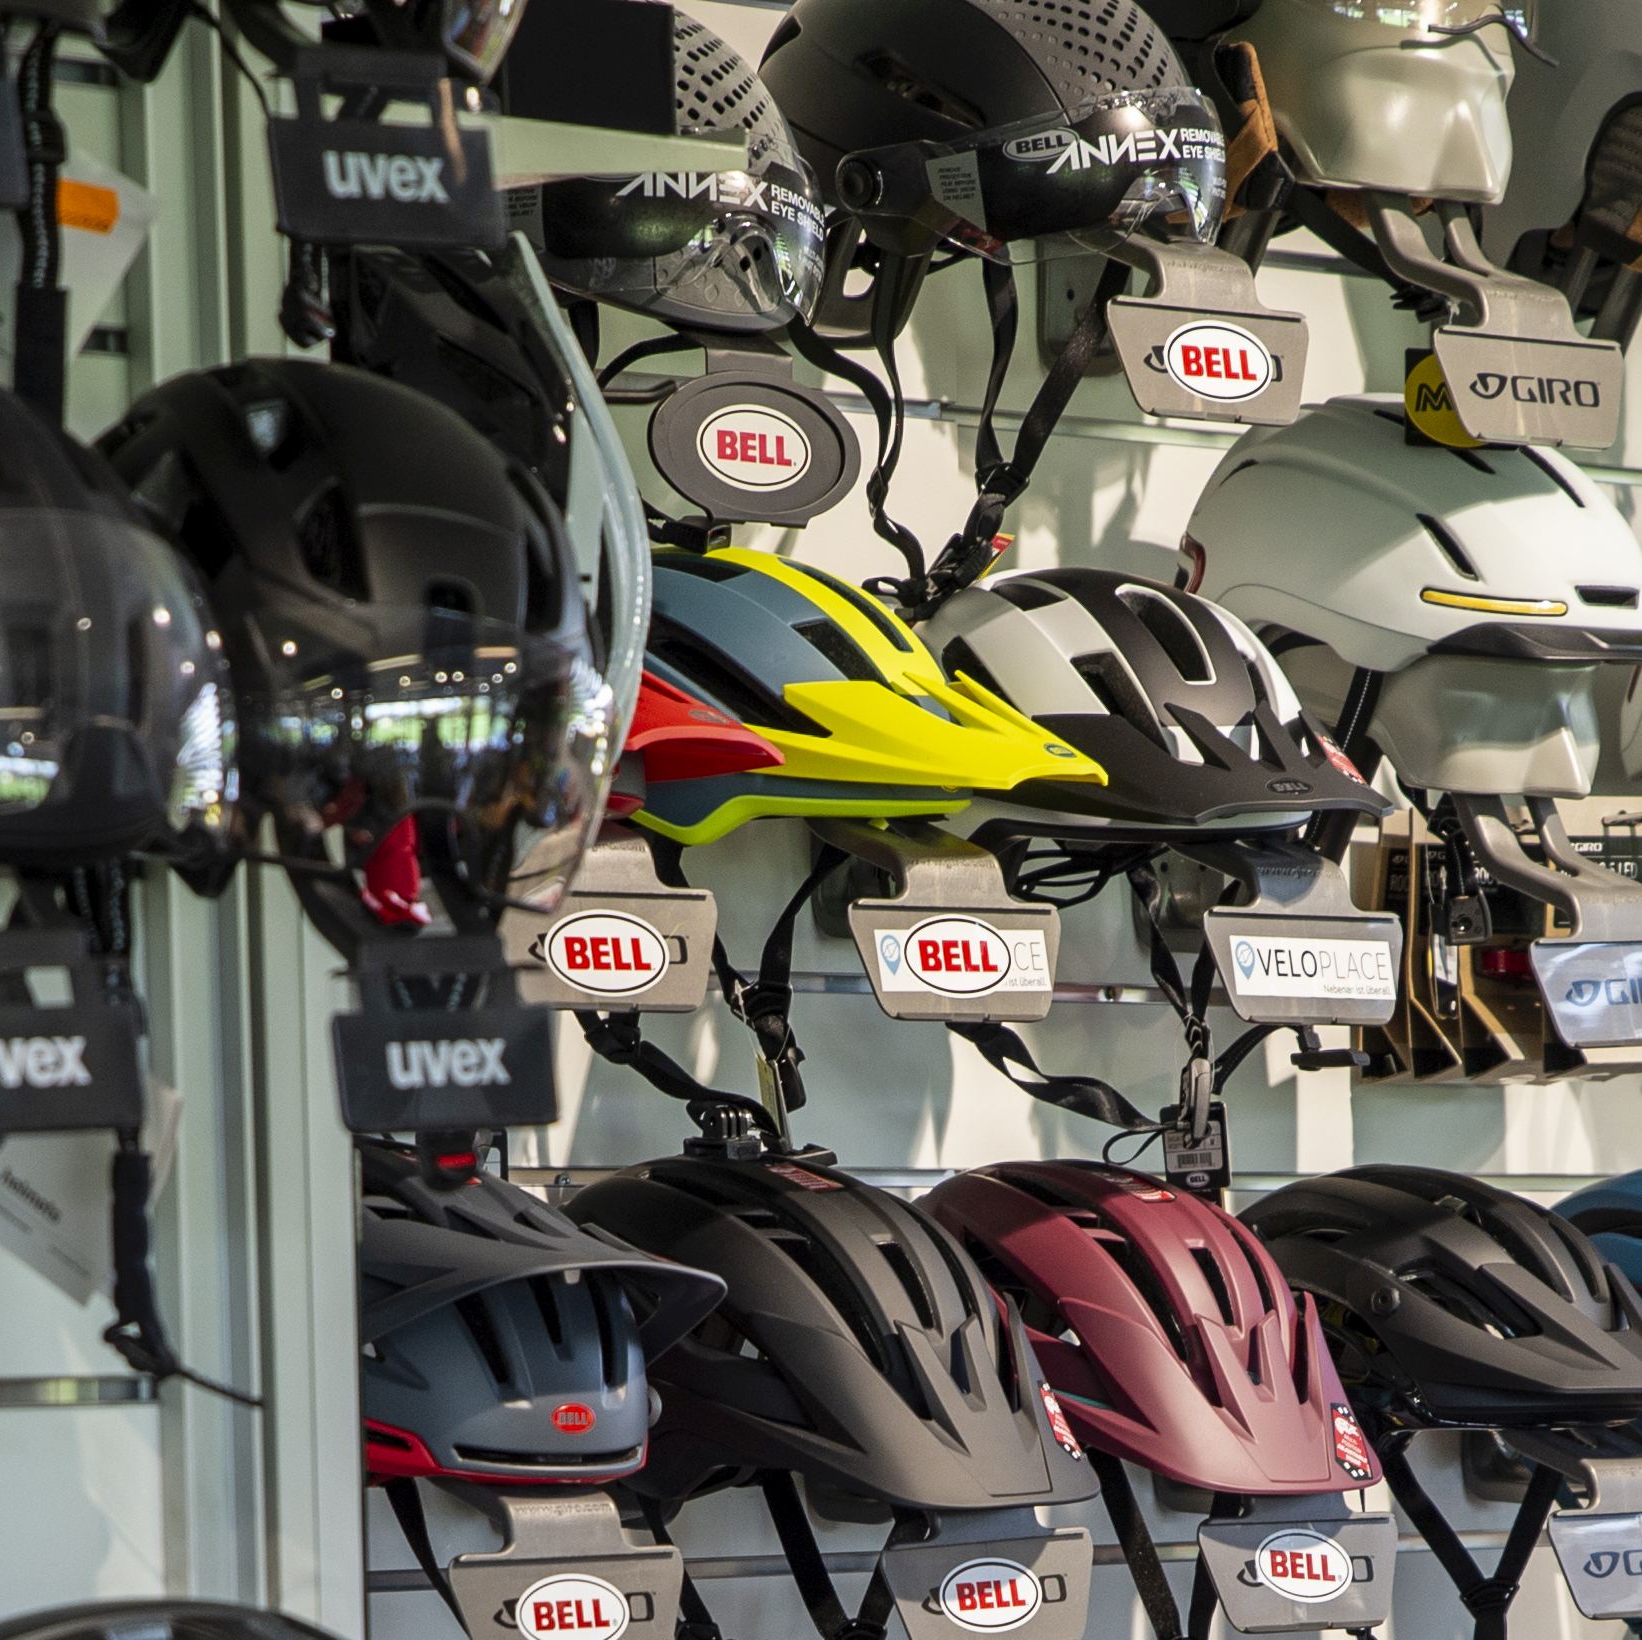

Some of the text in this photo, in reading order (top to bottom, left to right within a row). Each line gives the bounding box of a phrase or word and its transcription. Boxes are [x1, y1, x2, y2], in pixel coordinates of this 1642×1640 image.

[1018, 132, 1071, 157] BELL
[1047, 129, 1180, 174] ANNEX
[1182, 145, 1203, 158] EYE
[324, 150, 449, 204] uvex
[618, 171, 768, 209] ANNEX
[771, 184, 825, 224] REMOVABL
[771, 202, 824, 241] EYE SHIELD
[1181, 345, 1256, 382] BELL
[1509, 381, 1601, 408] GIRO
[716, 431, 793, 468] BELL
[564, 935, 651, 970] BELL
[918, 939, 996, 973] BELL
[1257, 947, 1390, 981] VELOPLACE
[387, 1037, 511, 1088] uvex
[1190, 1175, 1206, 1185] BELL
[559, 1412, 588, 1426] BELL
[1269, 1550, 1335, 1581] BELL
[957, 1581, 1025, 1609] BELL
[534, 1601, 610, 1630] BELL
